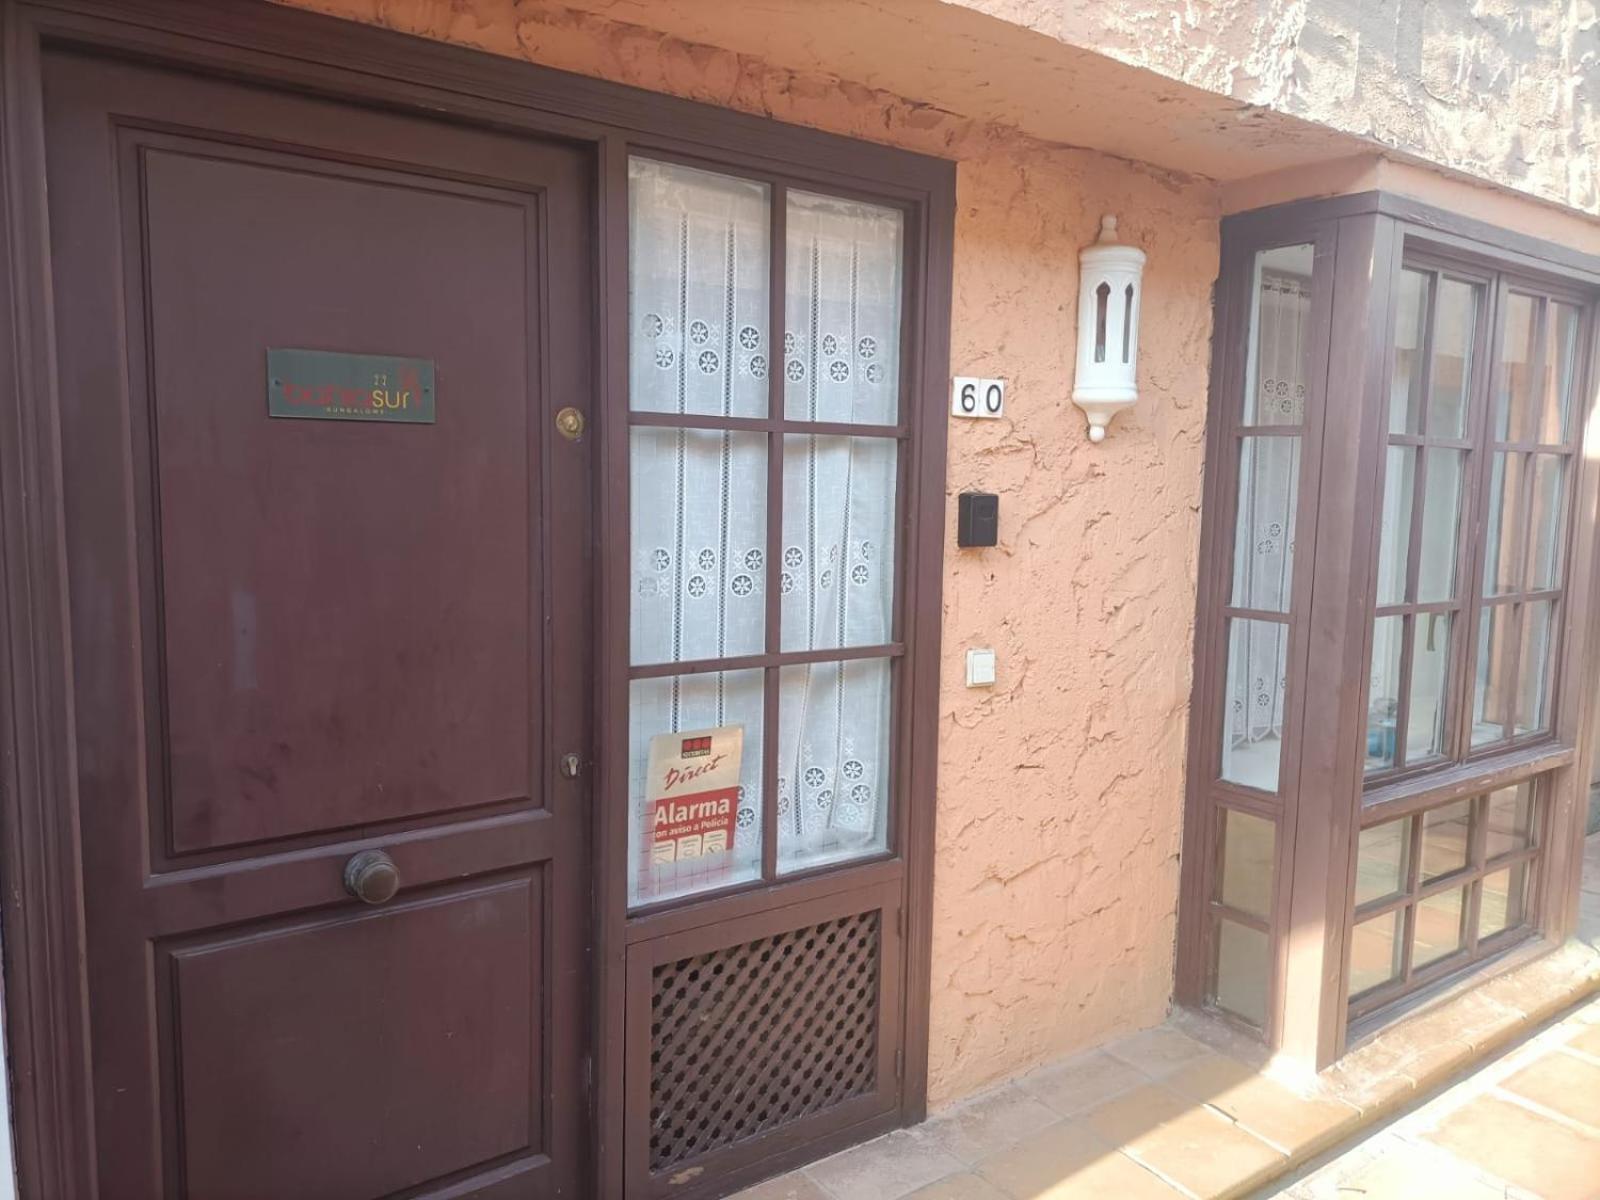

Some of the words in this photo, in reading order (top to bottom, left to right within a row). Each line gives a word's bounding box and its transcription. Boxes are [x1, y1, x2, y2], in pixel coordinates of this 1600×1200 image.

[961, 383, 1002, 413] 60
[664, 754, 728, 790] Direct
[655, 798, 730, 825] Alarma
[669, 826, 692, 836] aviso
